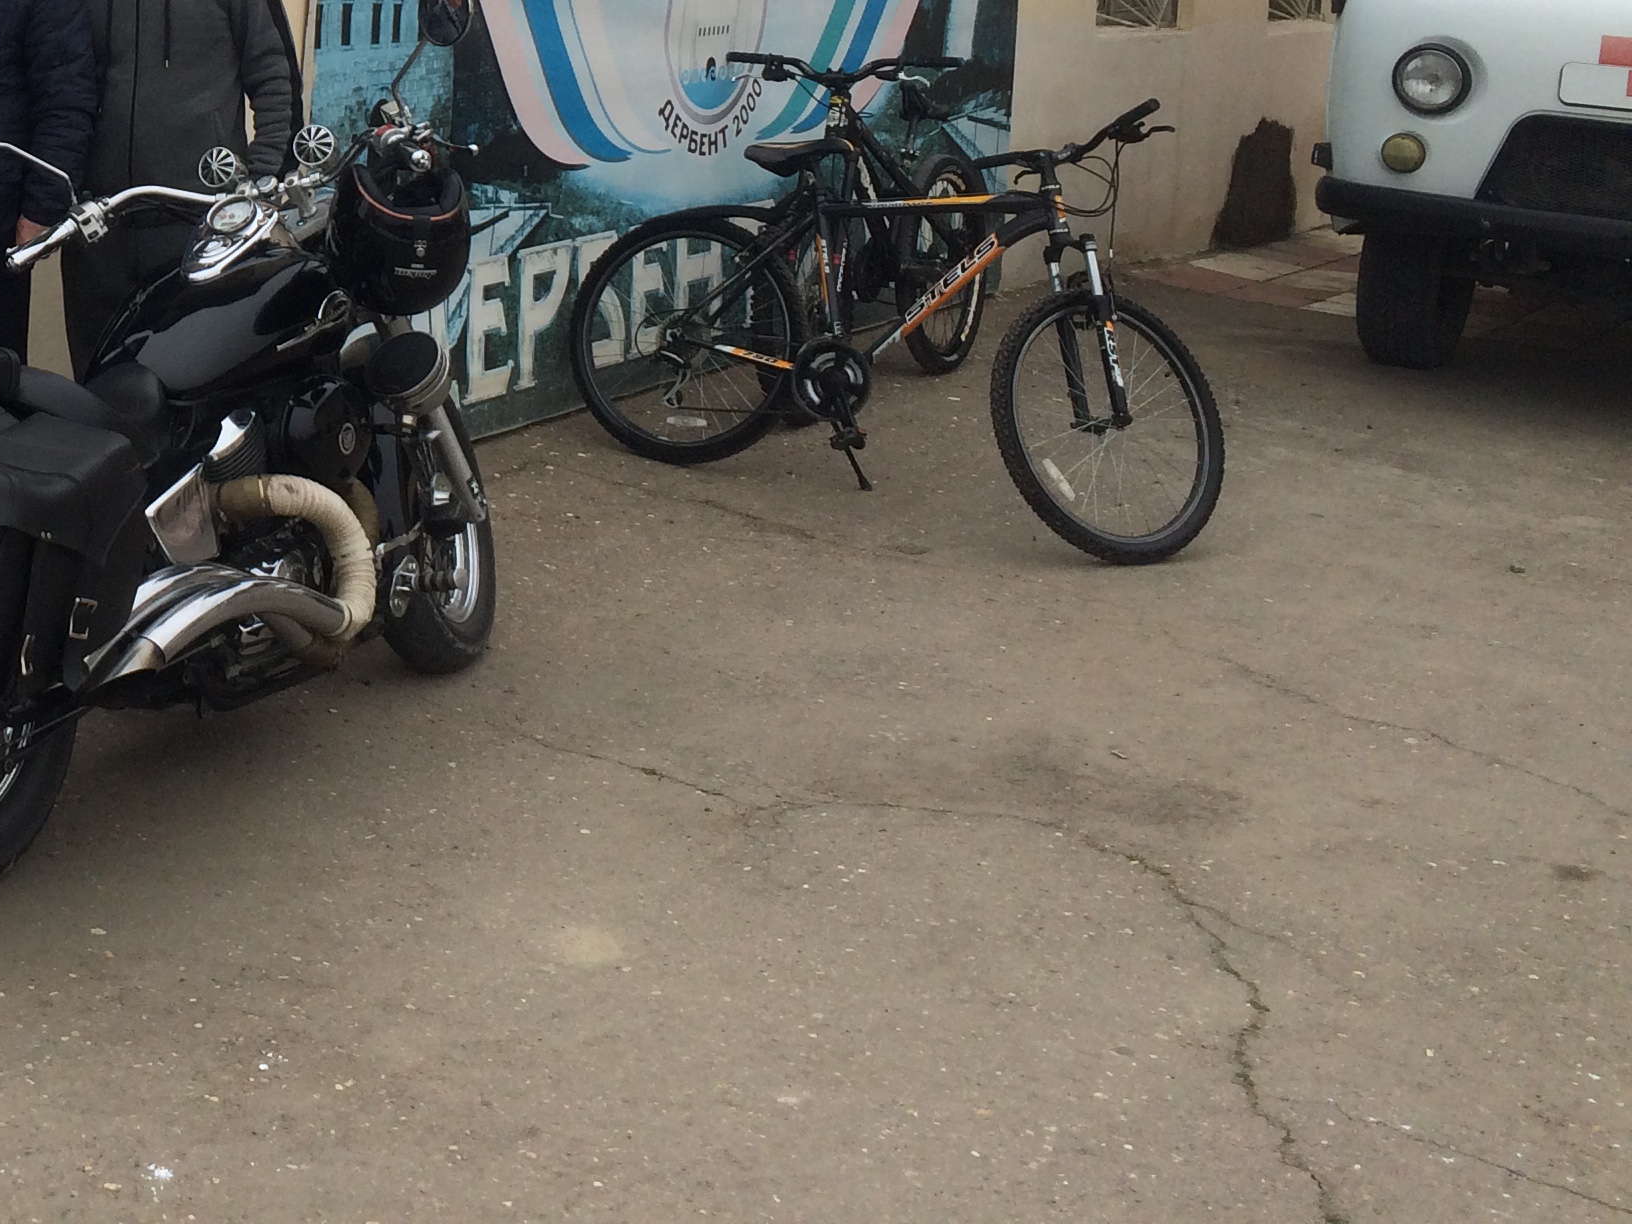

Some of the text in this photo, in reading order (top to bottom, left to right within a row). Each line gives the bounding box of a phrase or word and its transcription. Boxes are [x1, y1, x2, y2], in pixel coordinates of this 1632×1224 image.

[658, 98, 729, 156] ДЕРБЕНТ
[732, 78, 763, 137] 2000
[905, 232, 999, 325] STELS
